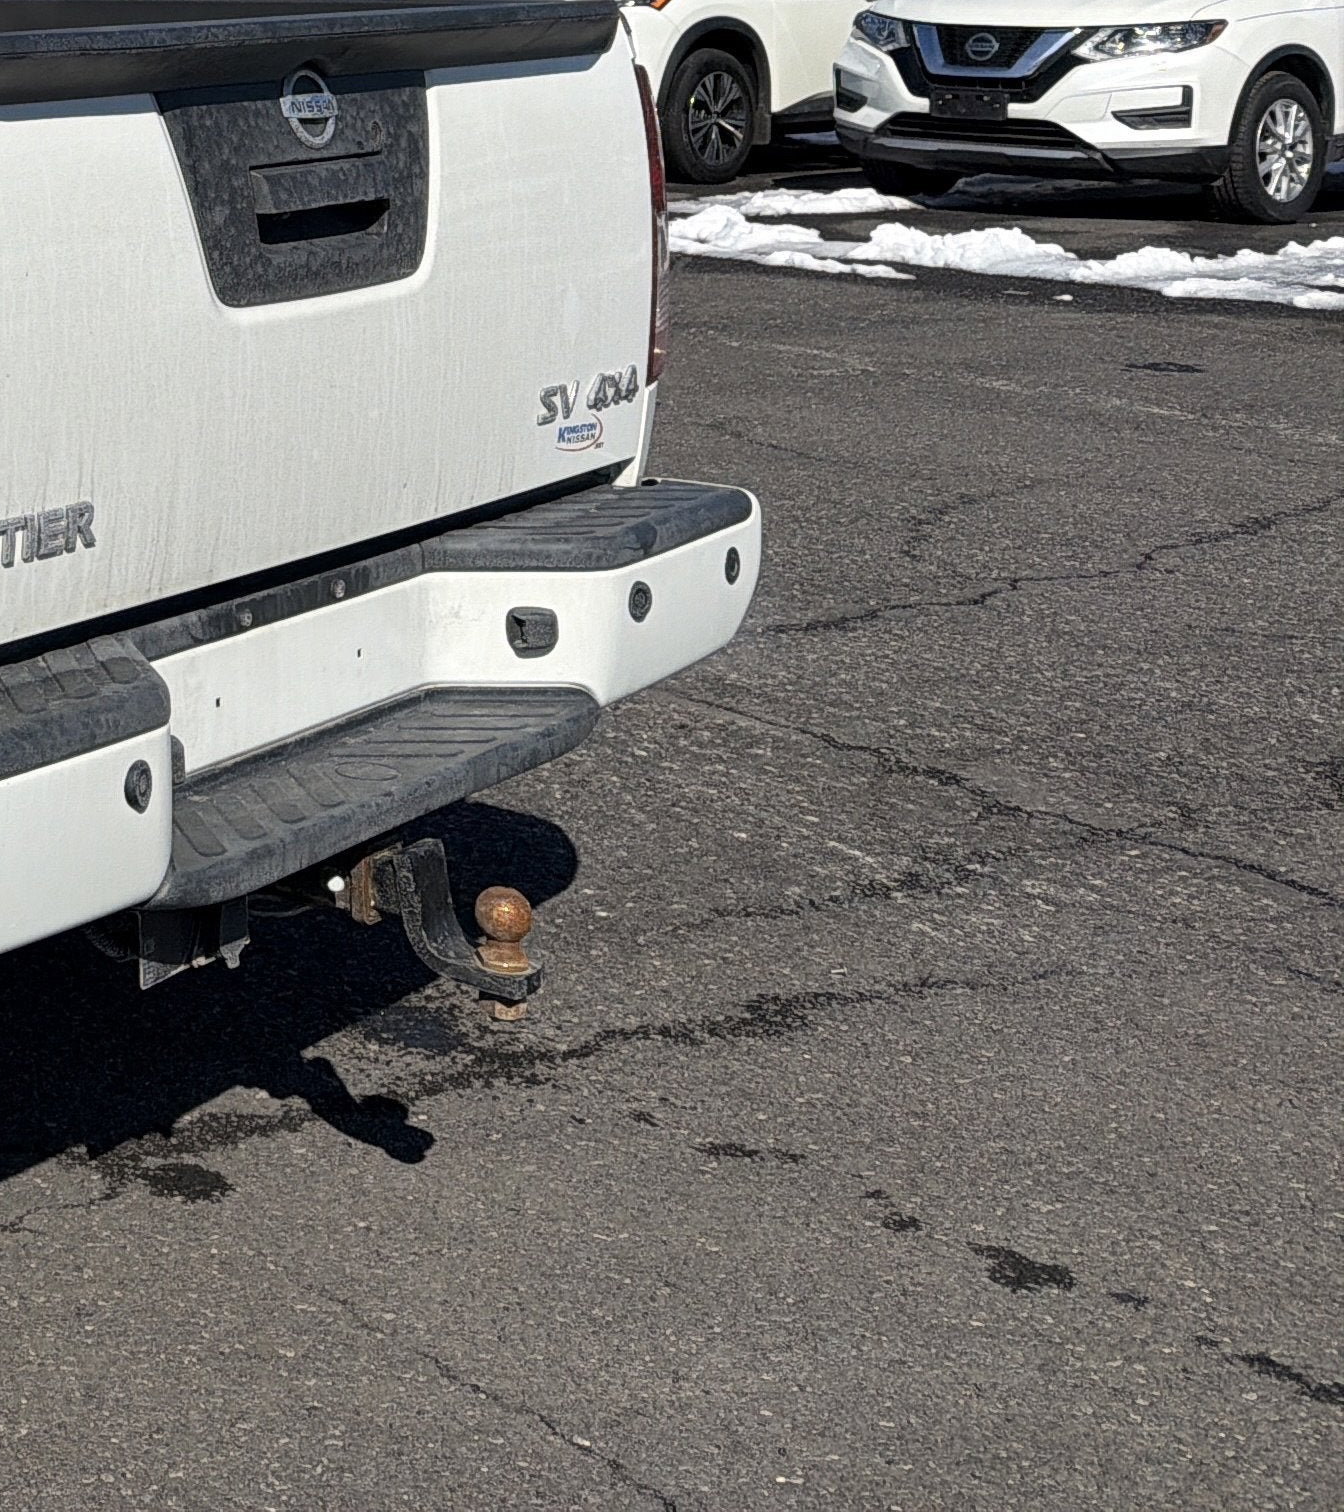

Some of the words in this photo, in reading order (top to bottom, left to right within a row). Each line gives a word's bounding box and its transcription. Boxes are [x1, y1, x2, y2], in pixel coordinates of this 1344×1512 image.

[290, 98, 334, 114] NISSAN
[536, 379, 580, 426] SV
[566, 432, 596, 444] NISSAN
